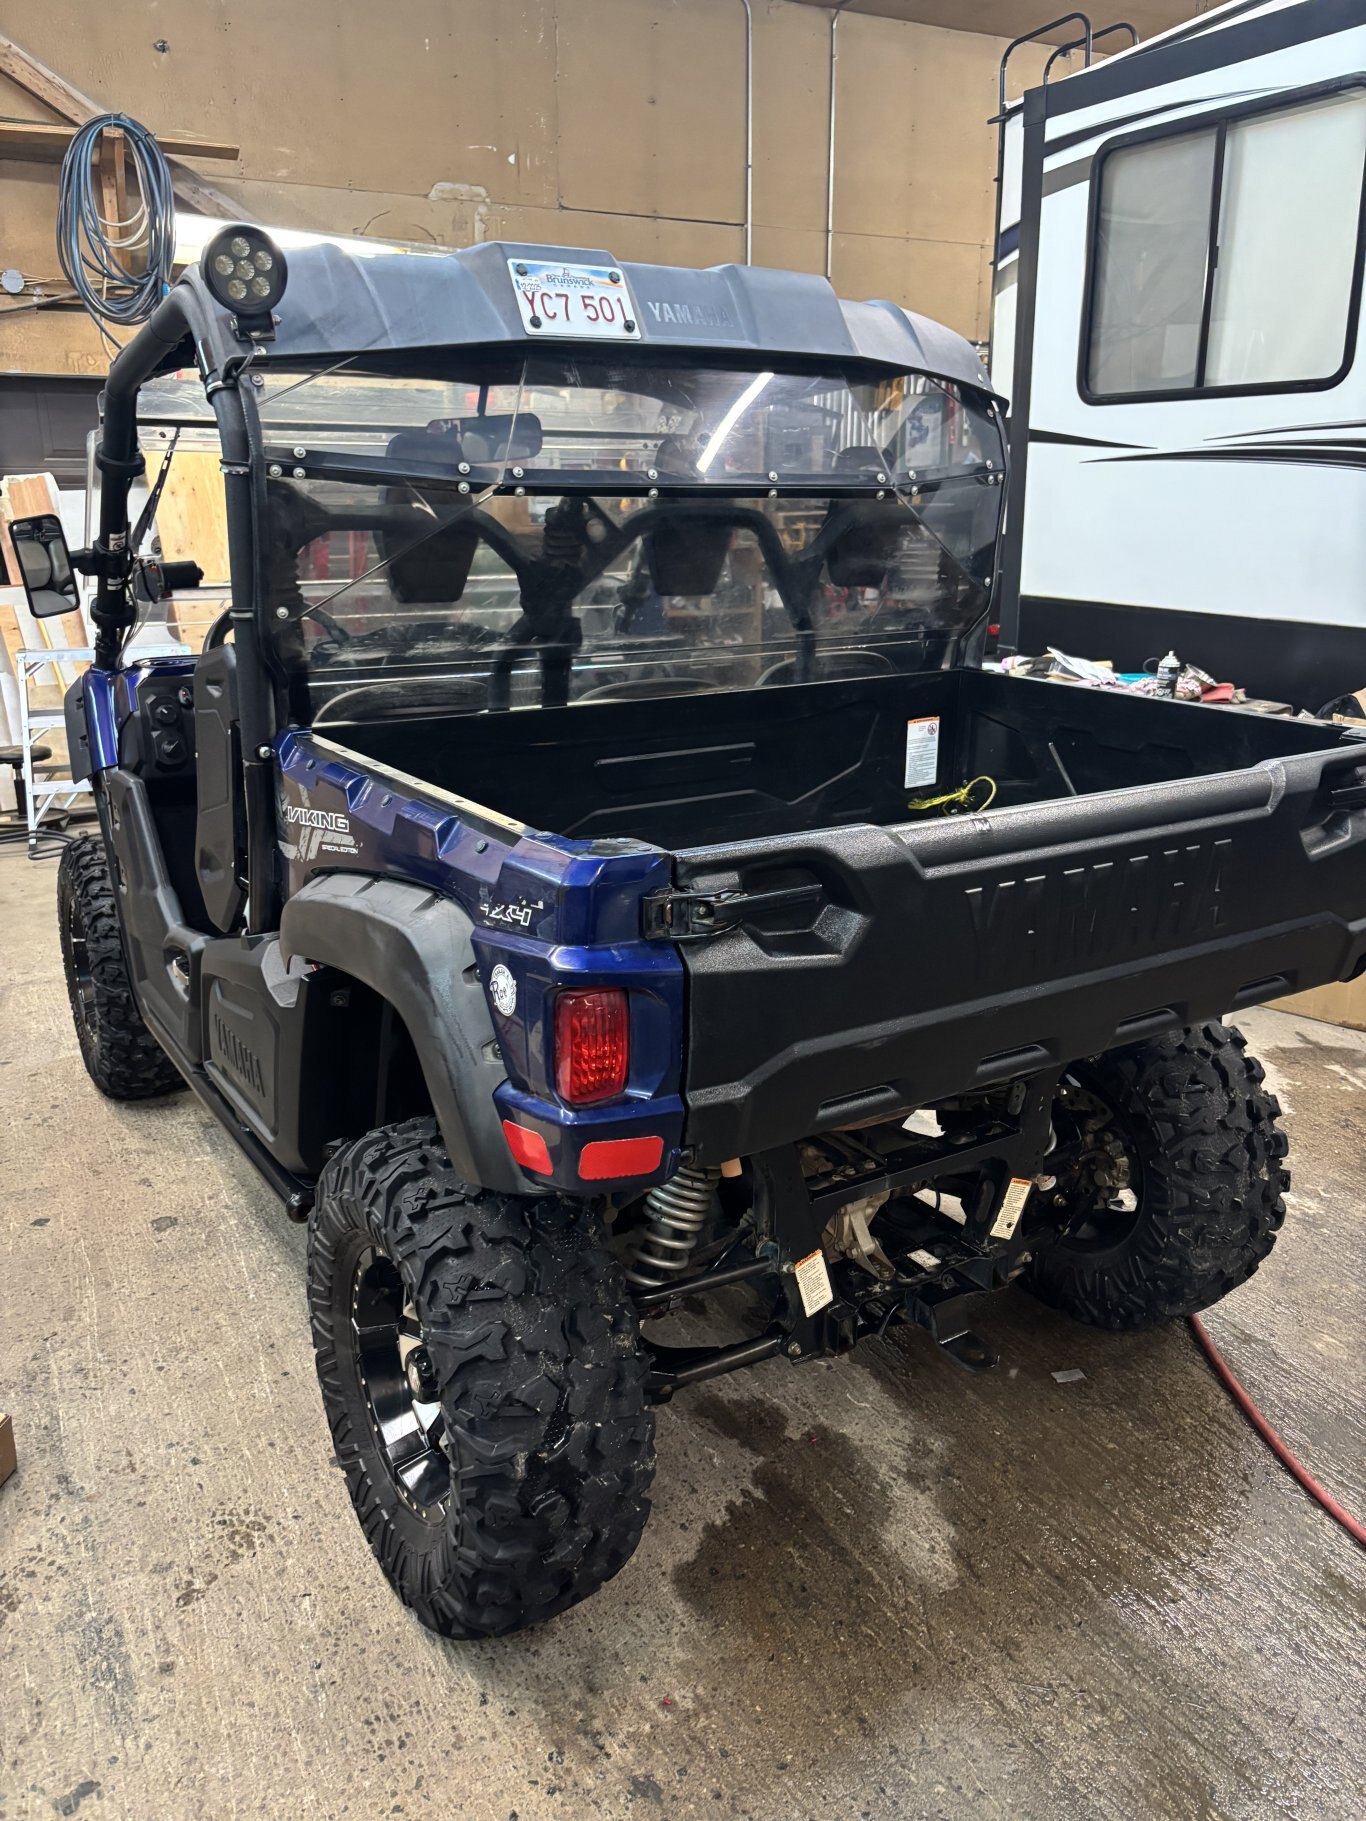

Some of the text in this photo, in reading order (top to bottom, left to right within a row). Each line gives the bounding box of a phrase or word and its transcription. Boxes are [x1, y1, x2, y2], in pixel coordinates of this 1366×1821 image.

[546, 273, 594, 287] Brunswick
[522, 291, 628, 323] YC7 501
[287, 806, 350, 833] VIKING
[963, 837, 1233, 974] YAMAHA
[214, 1013, 267, 1099] YAMAHA
